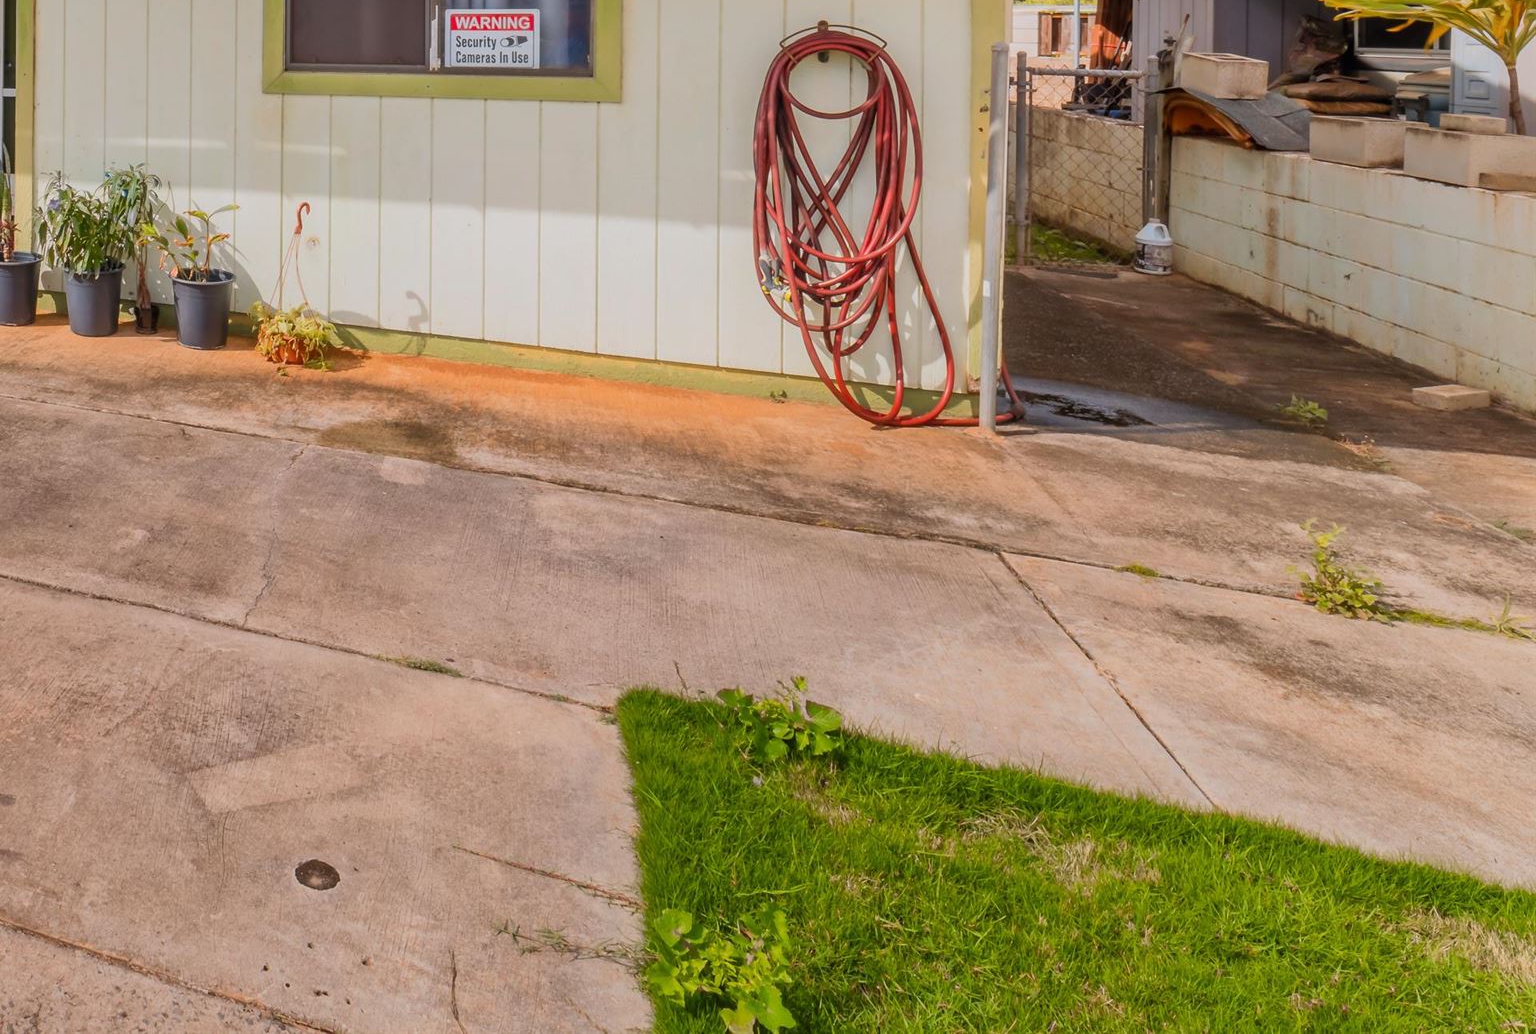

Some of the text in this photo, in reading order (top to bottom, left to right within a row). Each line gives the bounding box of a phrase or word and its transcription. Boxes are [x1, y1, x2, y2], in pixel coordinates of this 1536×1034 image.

[454, 16, 531, 30] WARNING
[455, 35, 497, 50] Security
[455, 51, 529, 64] Cameras In Use
